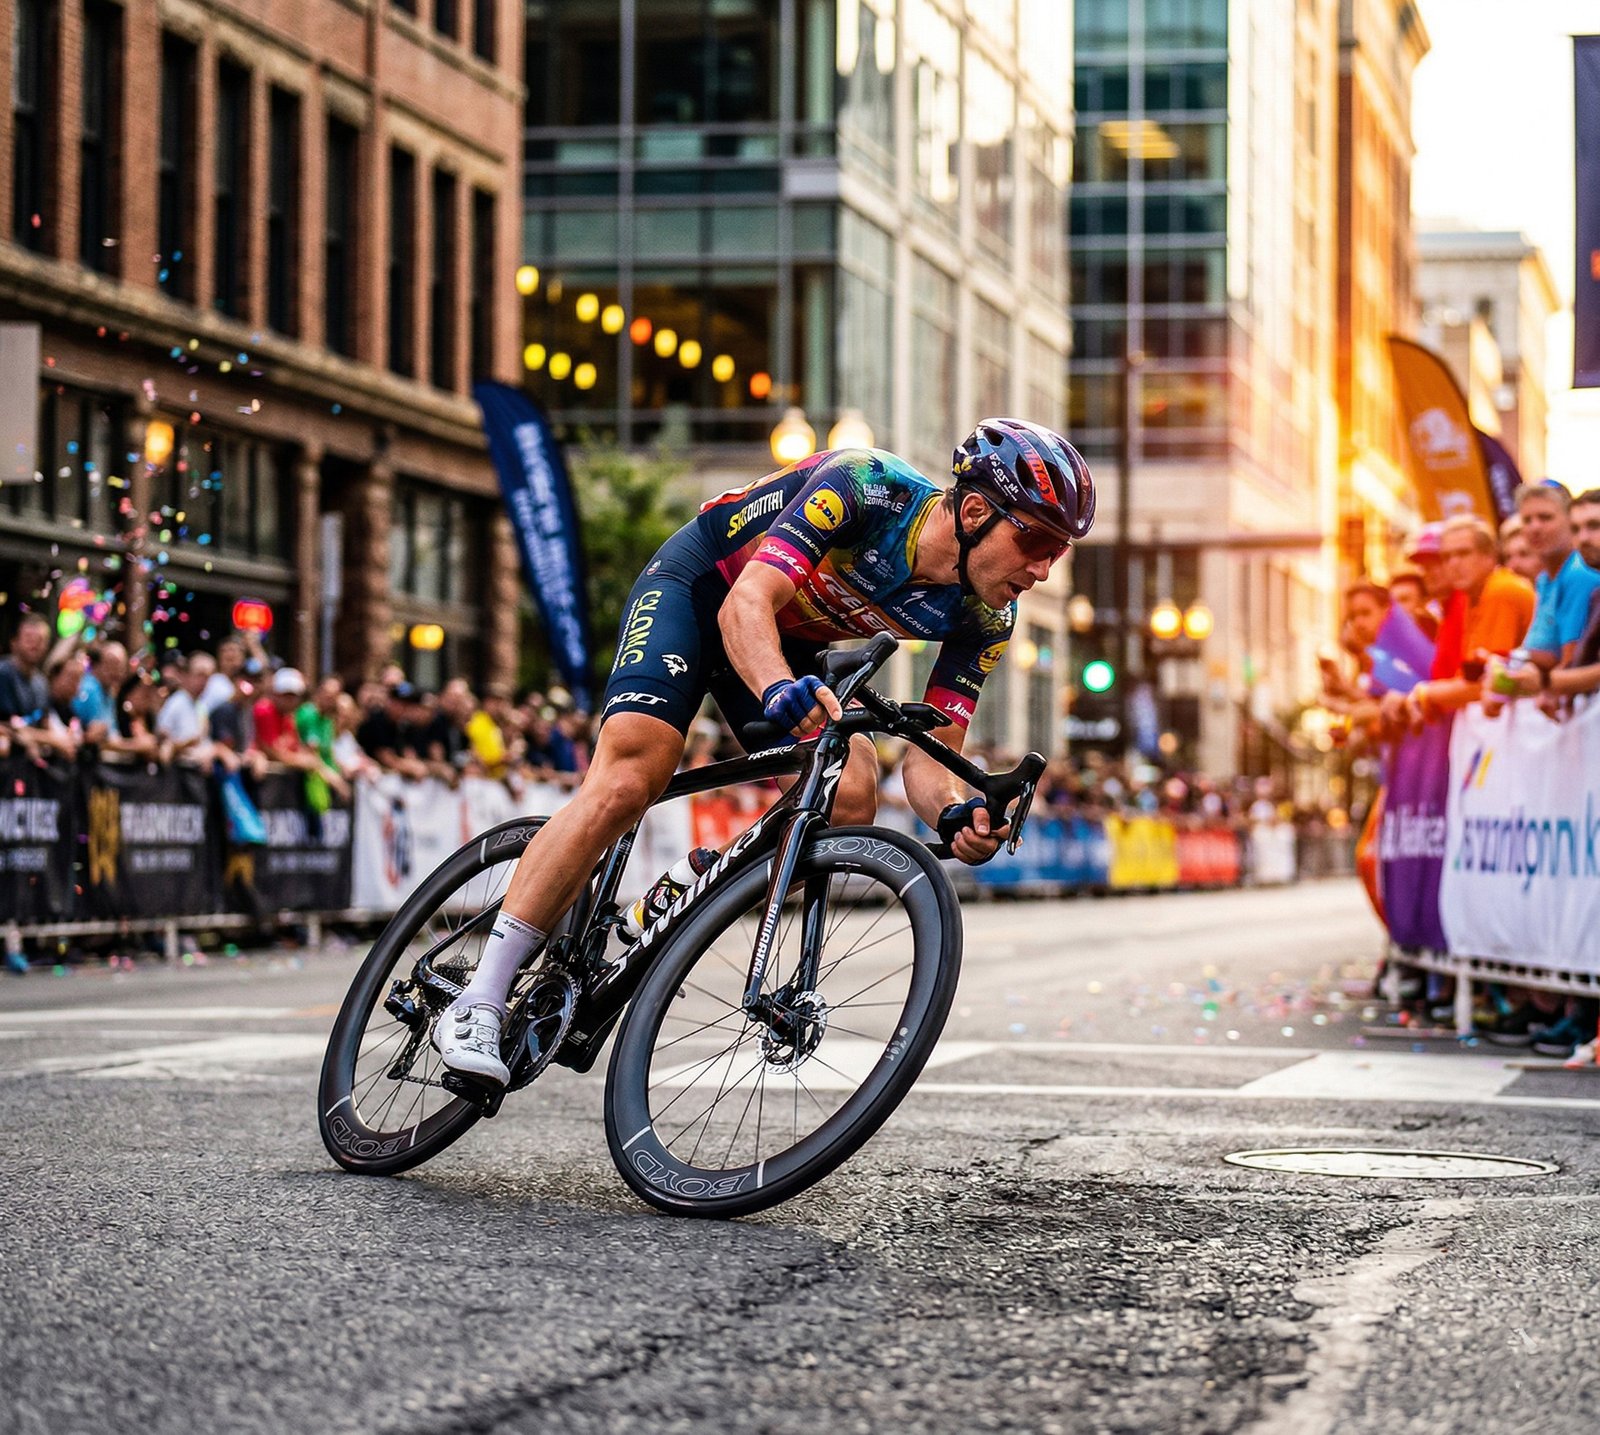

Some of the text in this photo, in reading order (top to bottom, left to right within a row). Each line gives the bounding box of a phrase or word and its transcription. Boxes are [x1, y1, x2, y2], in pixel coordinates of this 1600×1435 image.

[810, 496, 837, 527] LIDL
[806, 836, 912, 873] BOYD
[329, 1115, 410, 1157] BOYD
[632, 1149, 752, 1198] BOYD
